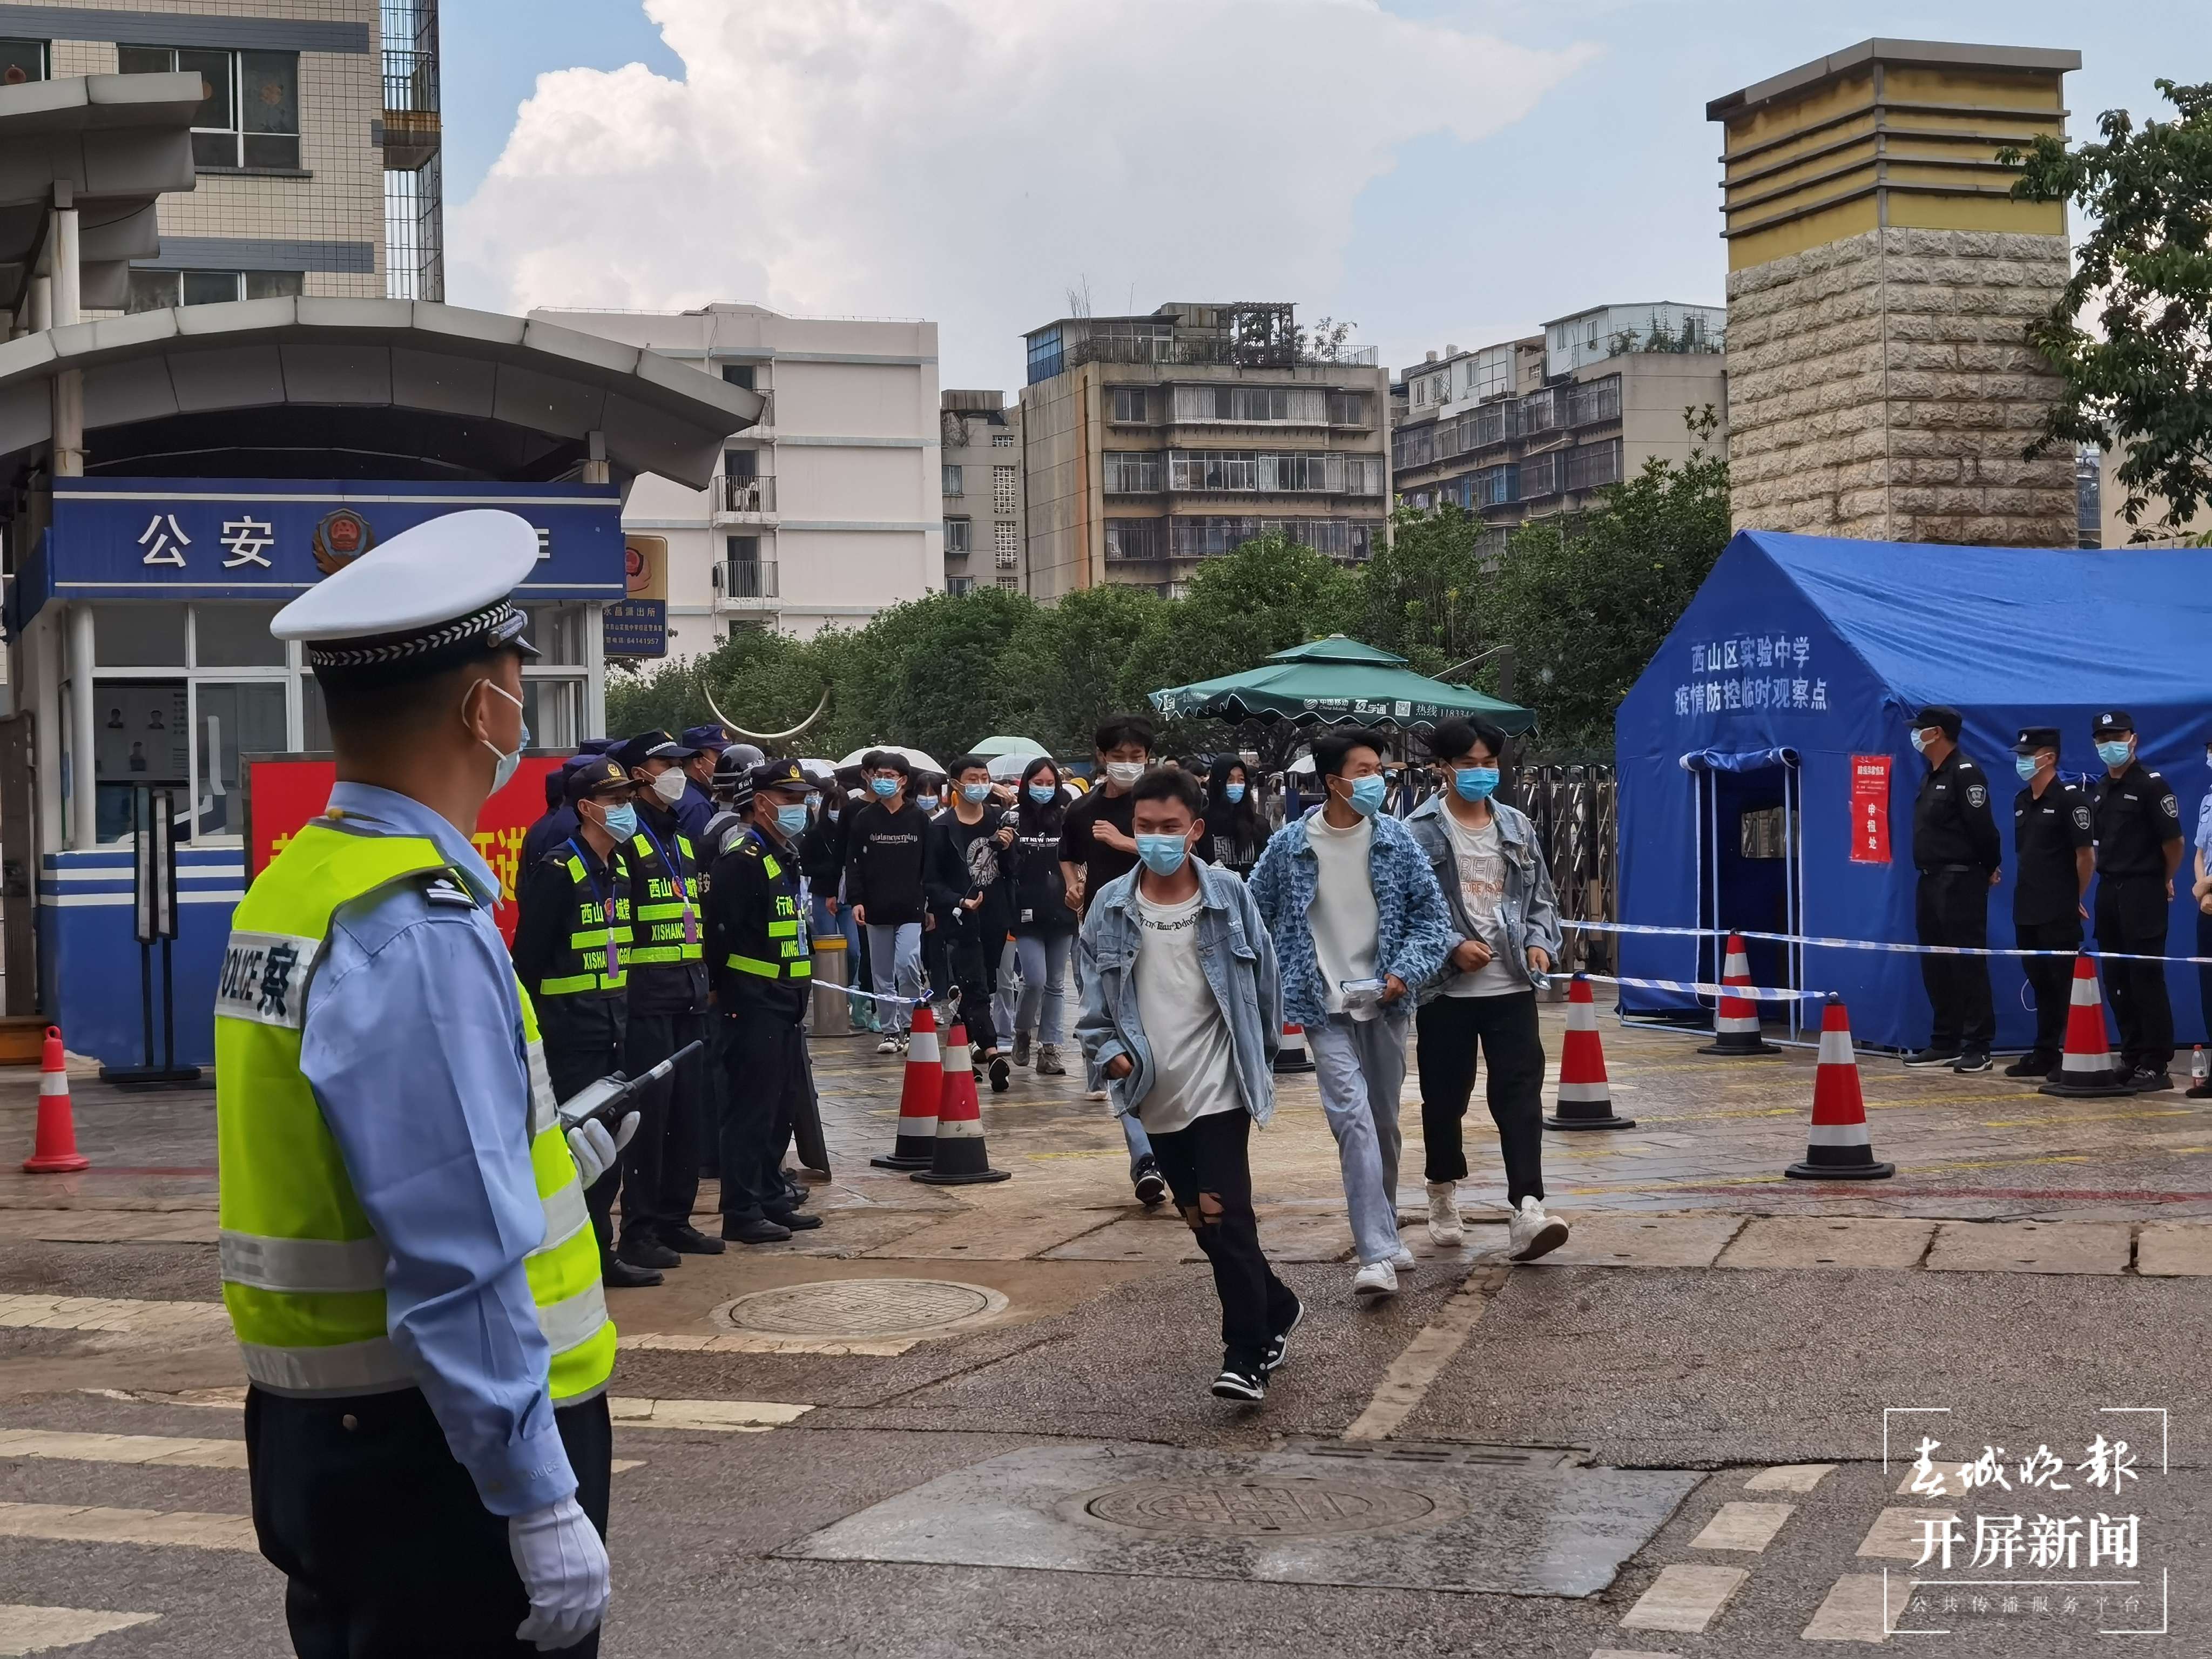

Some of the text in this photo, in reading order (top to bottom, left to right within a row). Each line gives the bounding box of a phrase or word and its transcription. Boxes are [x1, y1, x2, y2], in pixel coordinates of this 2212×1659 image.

[138, 515, 274, 568] 公安
[1691, 635, 1810, 673] 西山区实验中学
[1319, 698, 1348, 706] 中国移动
[1675, 675, 1827, 717] 疫情防控临时观察点
[648, 878, 672, 898] 西山
[579, 901, 604, 925] 西山
[776, 895, 795, 916] 行政
[257, 942, 299, 1016] 察
